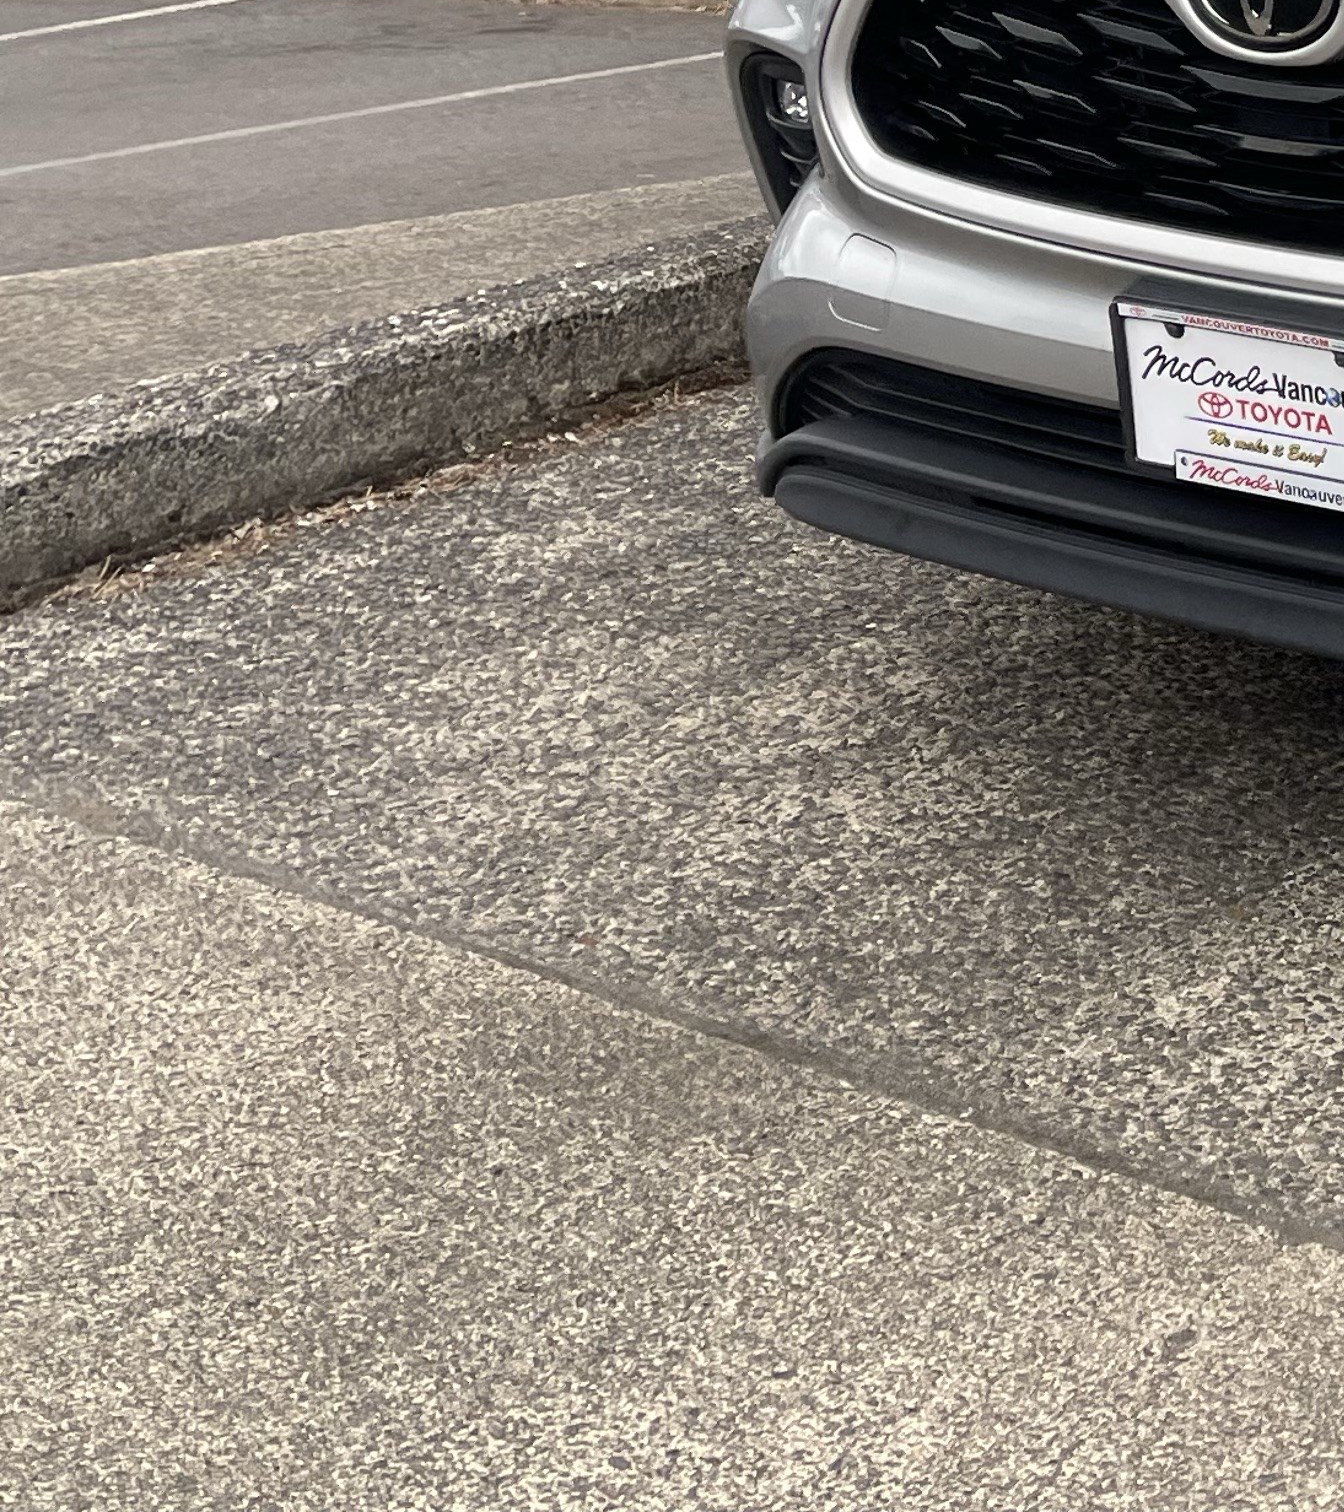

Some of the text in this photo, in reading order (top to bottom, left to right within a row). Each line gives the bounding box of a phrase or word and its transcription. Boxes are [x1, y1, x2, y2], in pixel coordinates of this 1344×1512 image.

[1181, 314, 1330, 348] VANCOUVERTOYOTA.COM
[1235, 398, 1333, 436] TOYOTA
[1207, 428, 1231, 448] We
[1233, 437, 1269, 455] make
